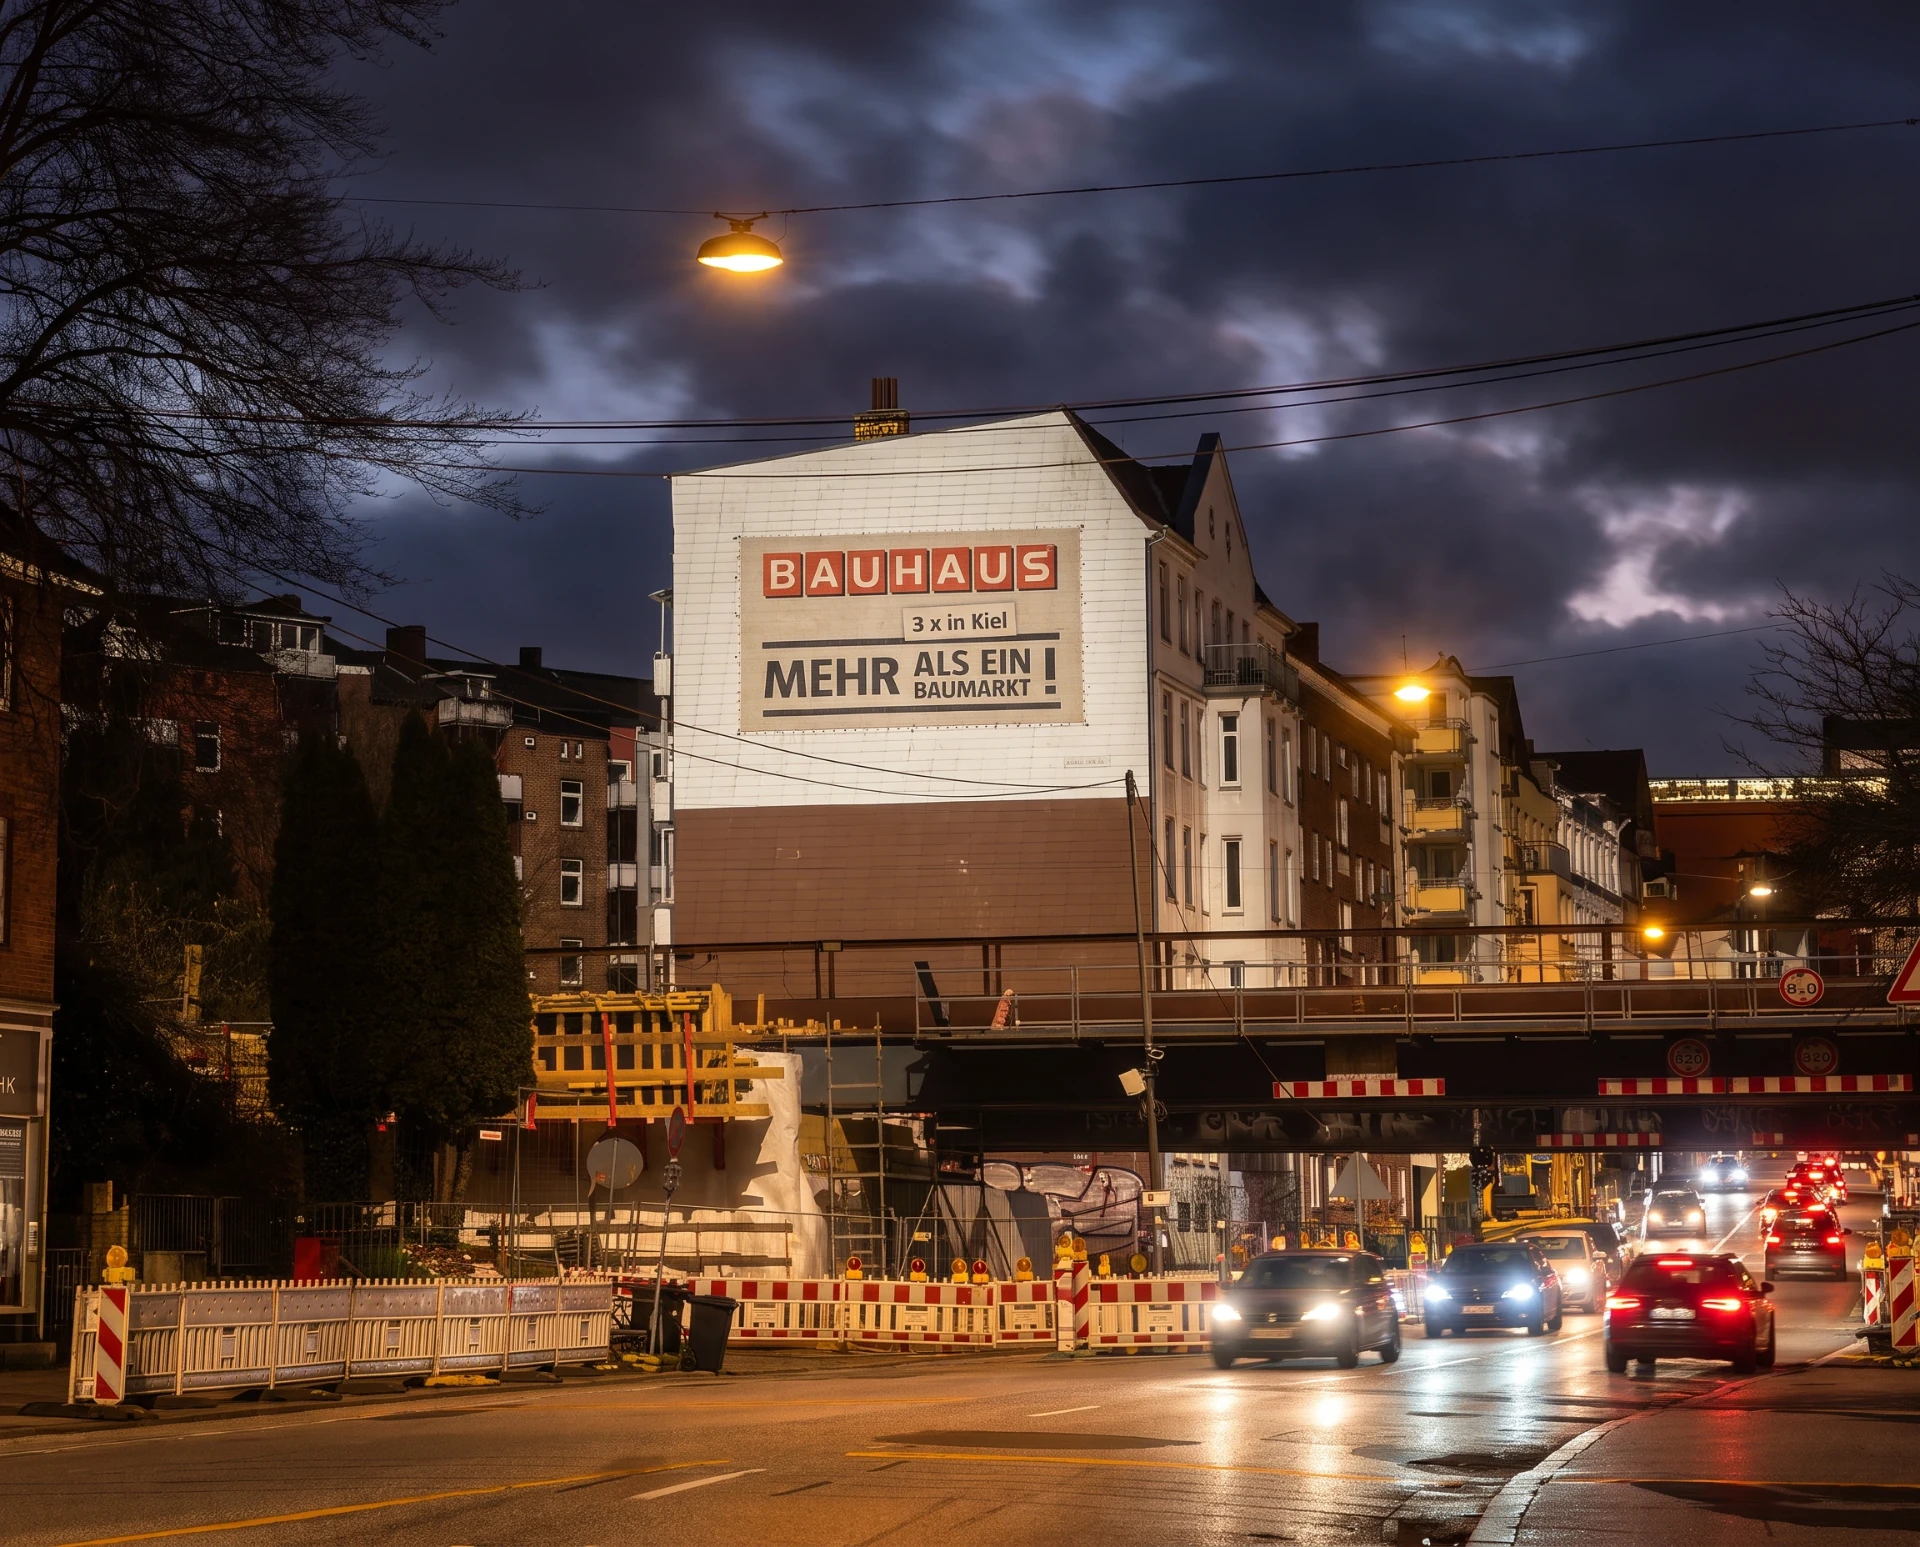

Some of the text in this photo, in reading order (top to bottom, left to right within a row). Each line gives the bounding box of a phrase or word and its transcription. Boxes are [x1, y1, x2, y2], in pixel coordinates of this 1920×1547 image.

[770, 551, 1050, 590] BAUHAUS
[912, 611, 1007, 632] 3 x in Kiel
[764, 656, 900, 699] MEHR
[913, 648, 1031, 677] ALS EIN
[1045, 647, 1057, 695] !
[914, 678, 1031, 699] BAUMARKT
